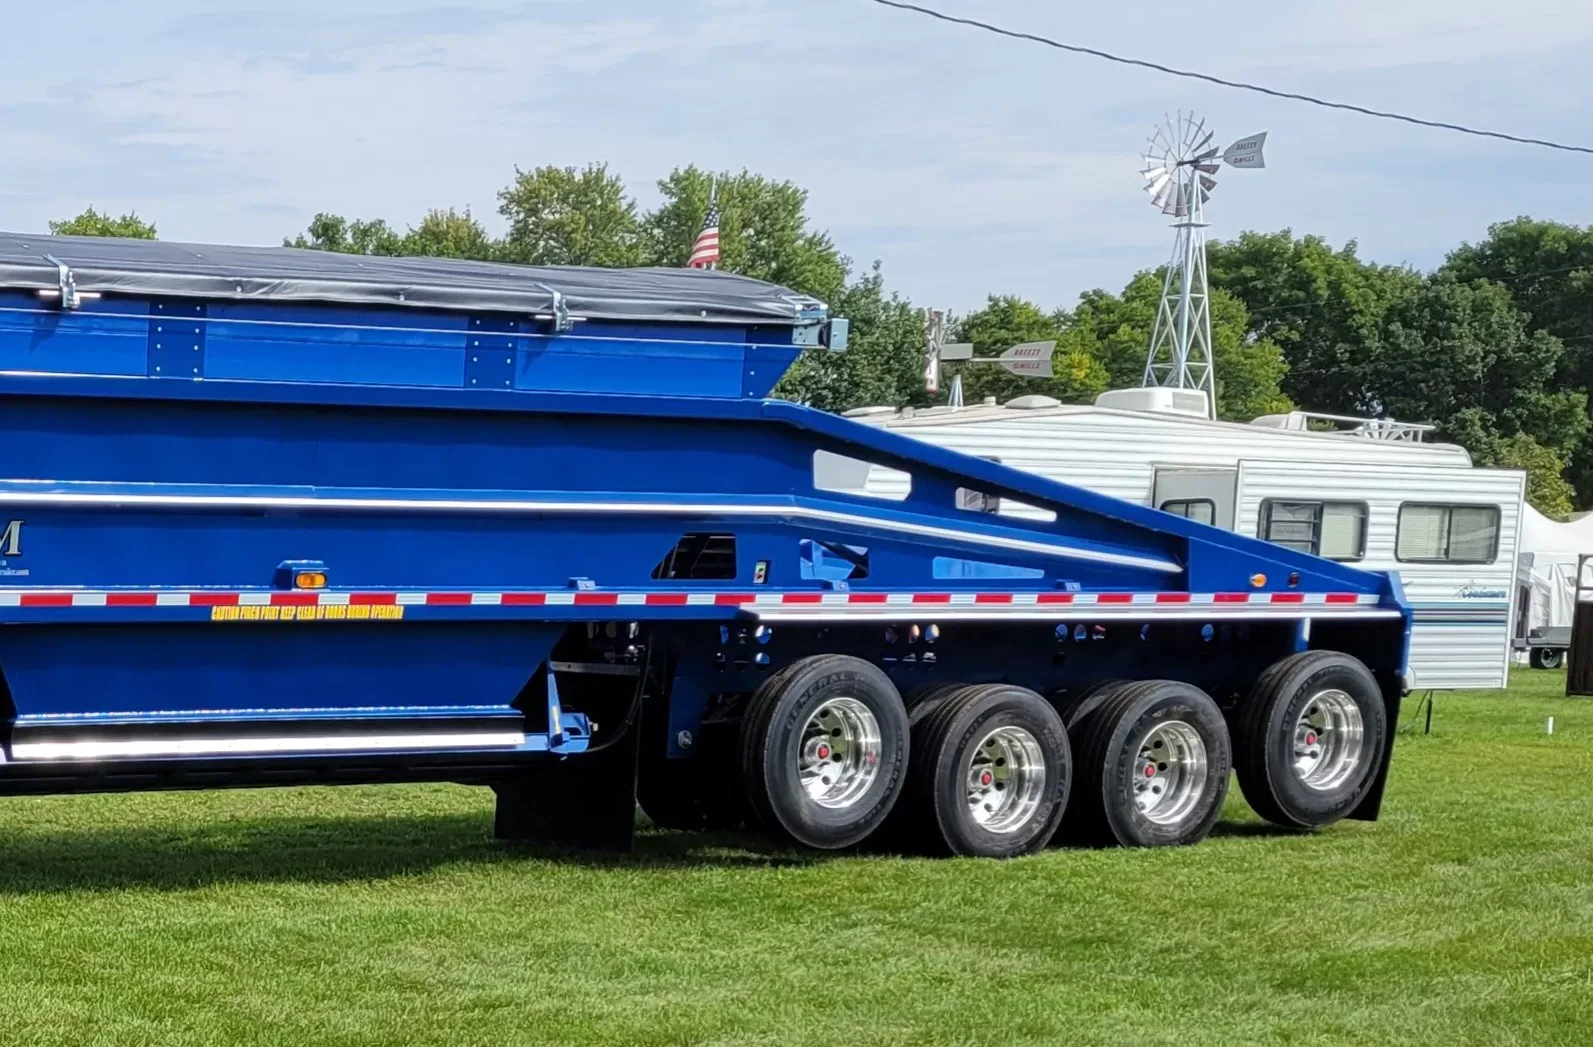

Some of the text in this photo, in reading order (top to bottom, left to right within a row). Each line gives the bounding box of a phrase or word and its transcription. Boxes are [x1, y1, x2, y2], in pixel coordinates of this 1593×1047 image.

[211, 605, 240, 620] CAUTION
[260, 605, 281, 620] POINT
[280, 605, 297, 619] KEEP
[316, 605, 326, 619] OF
